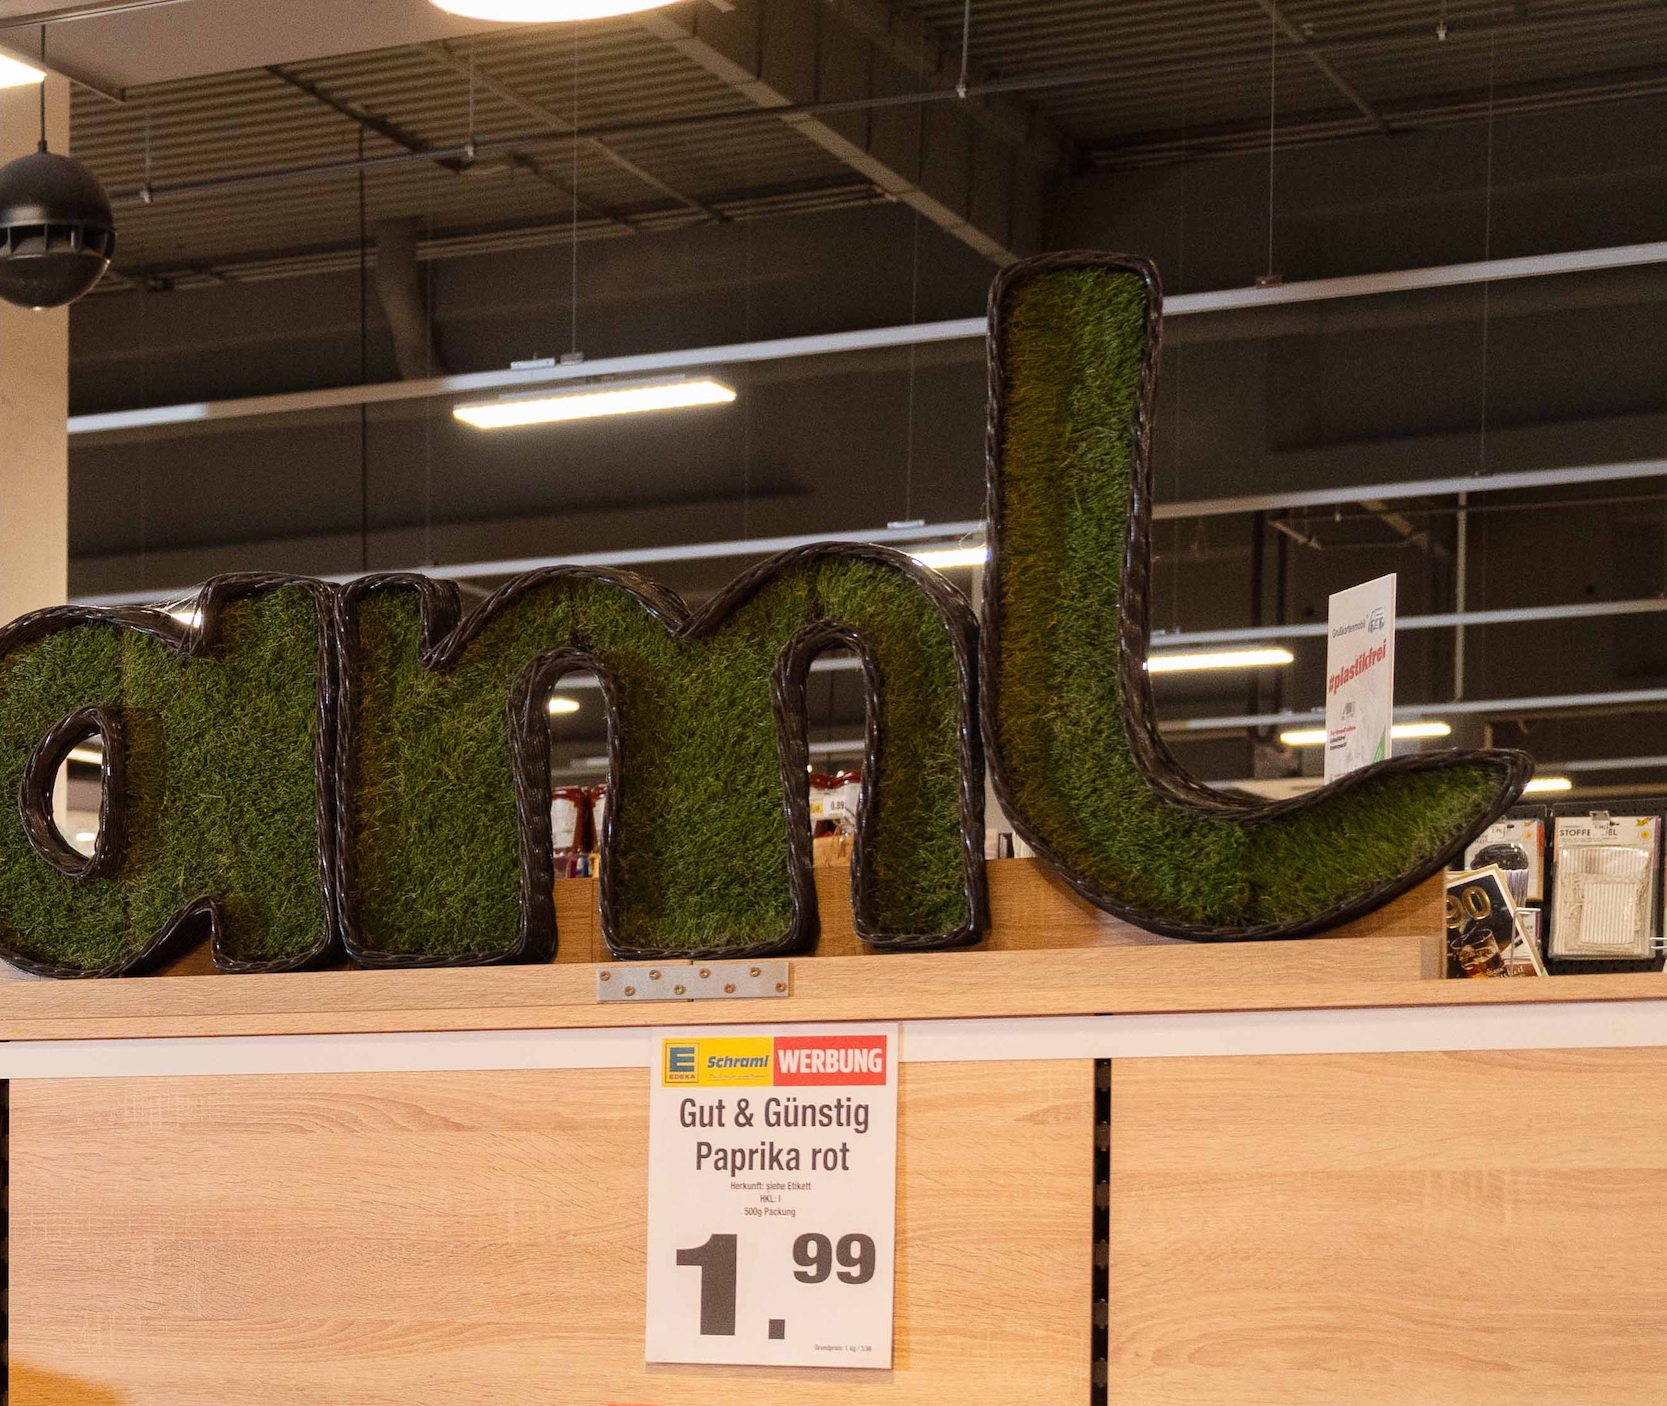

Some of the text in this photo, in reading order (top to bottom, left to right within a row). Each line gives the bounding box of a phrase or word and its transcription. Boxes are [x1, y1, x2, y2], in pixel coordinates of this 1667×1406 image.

[707, 1055, 770, 1069] Schraml
[778, 1048, 883, 1074] WERBUNG
[680, 1097, 870, 1134] Gut & Günstig
[696, 1141, 850, 1177] Paprika rot
